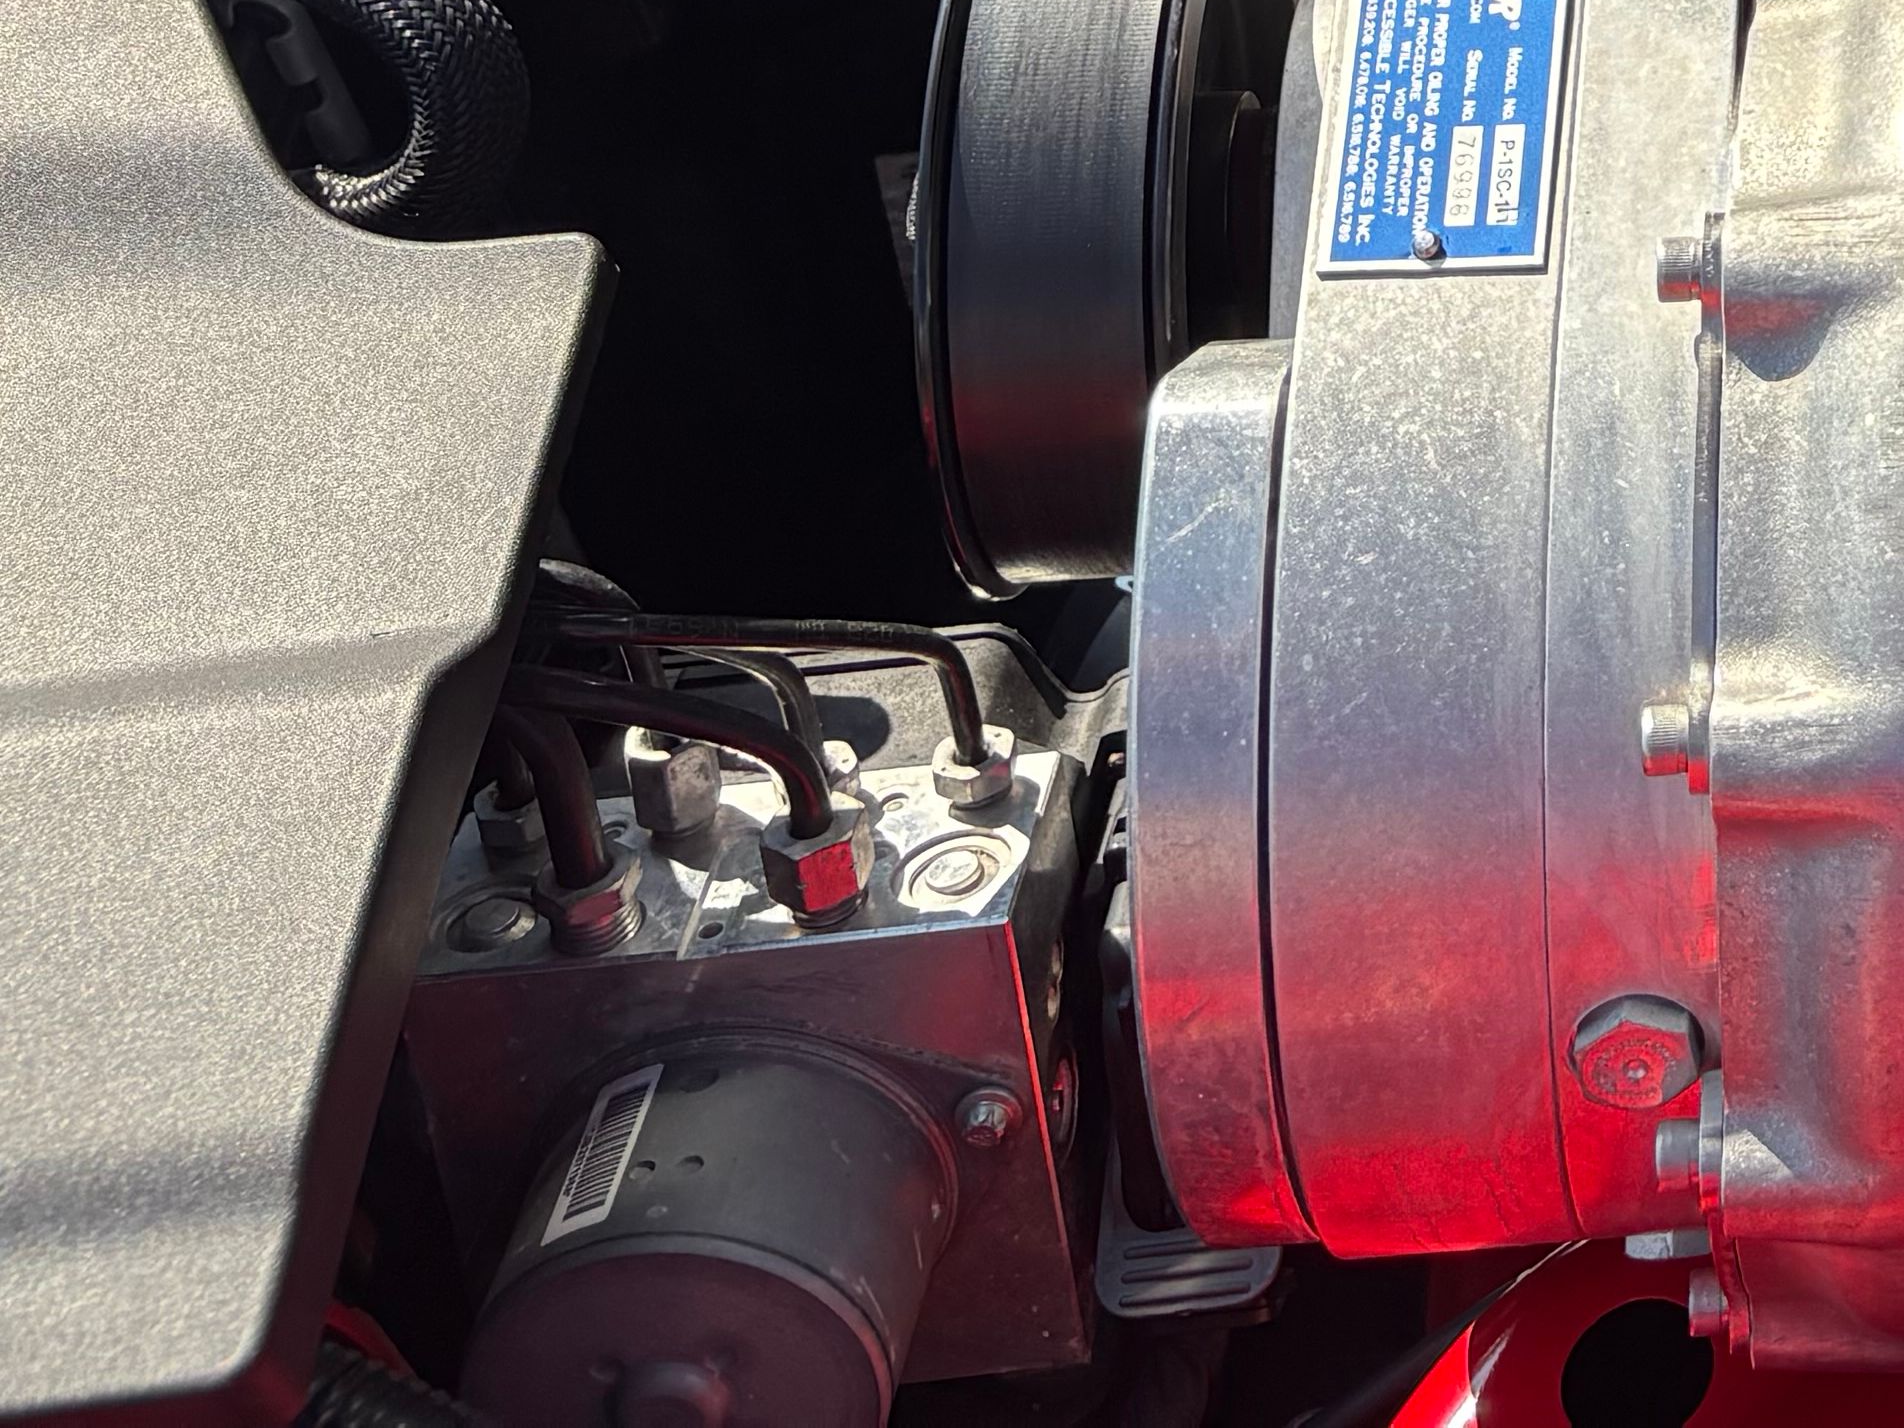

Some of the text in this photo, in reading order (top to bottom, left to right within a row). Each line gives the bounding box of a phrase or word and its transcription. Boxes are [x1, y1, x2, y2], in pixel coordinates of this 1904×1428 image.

[1397, 40, 1412, 74] WILL
[1409, 17, 1430, 102] PROCEDURE
[1430, 13, 1449, 66] PROPER
[1464, 49, 1484, 96] SERIAL
[1504, 47, 1523, 94] MODEL
[1392, 87, 1407, 121] VOID
[1406, 113, 1419, 134] OR
[1360, 80, 1391, 208] TECHNOLOGIES
[1420, 121, 1437, 151] AND
[1382, 134, 1401, 215] WARRANTY
[1397, 145, 1415, 217] IMPROPER
